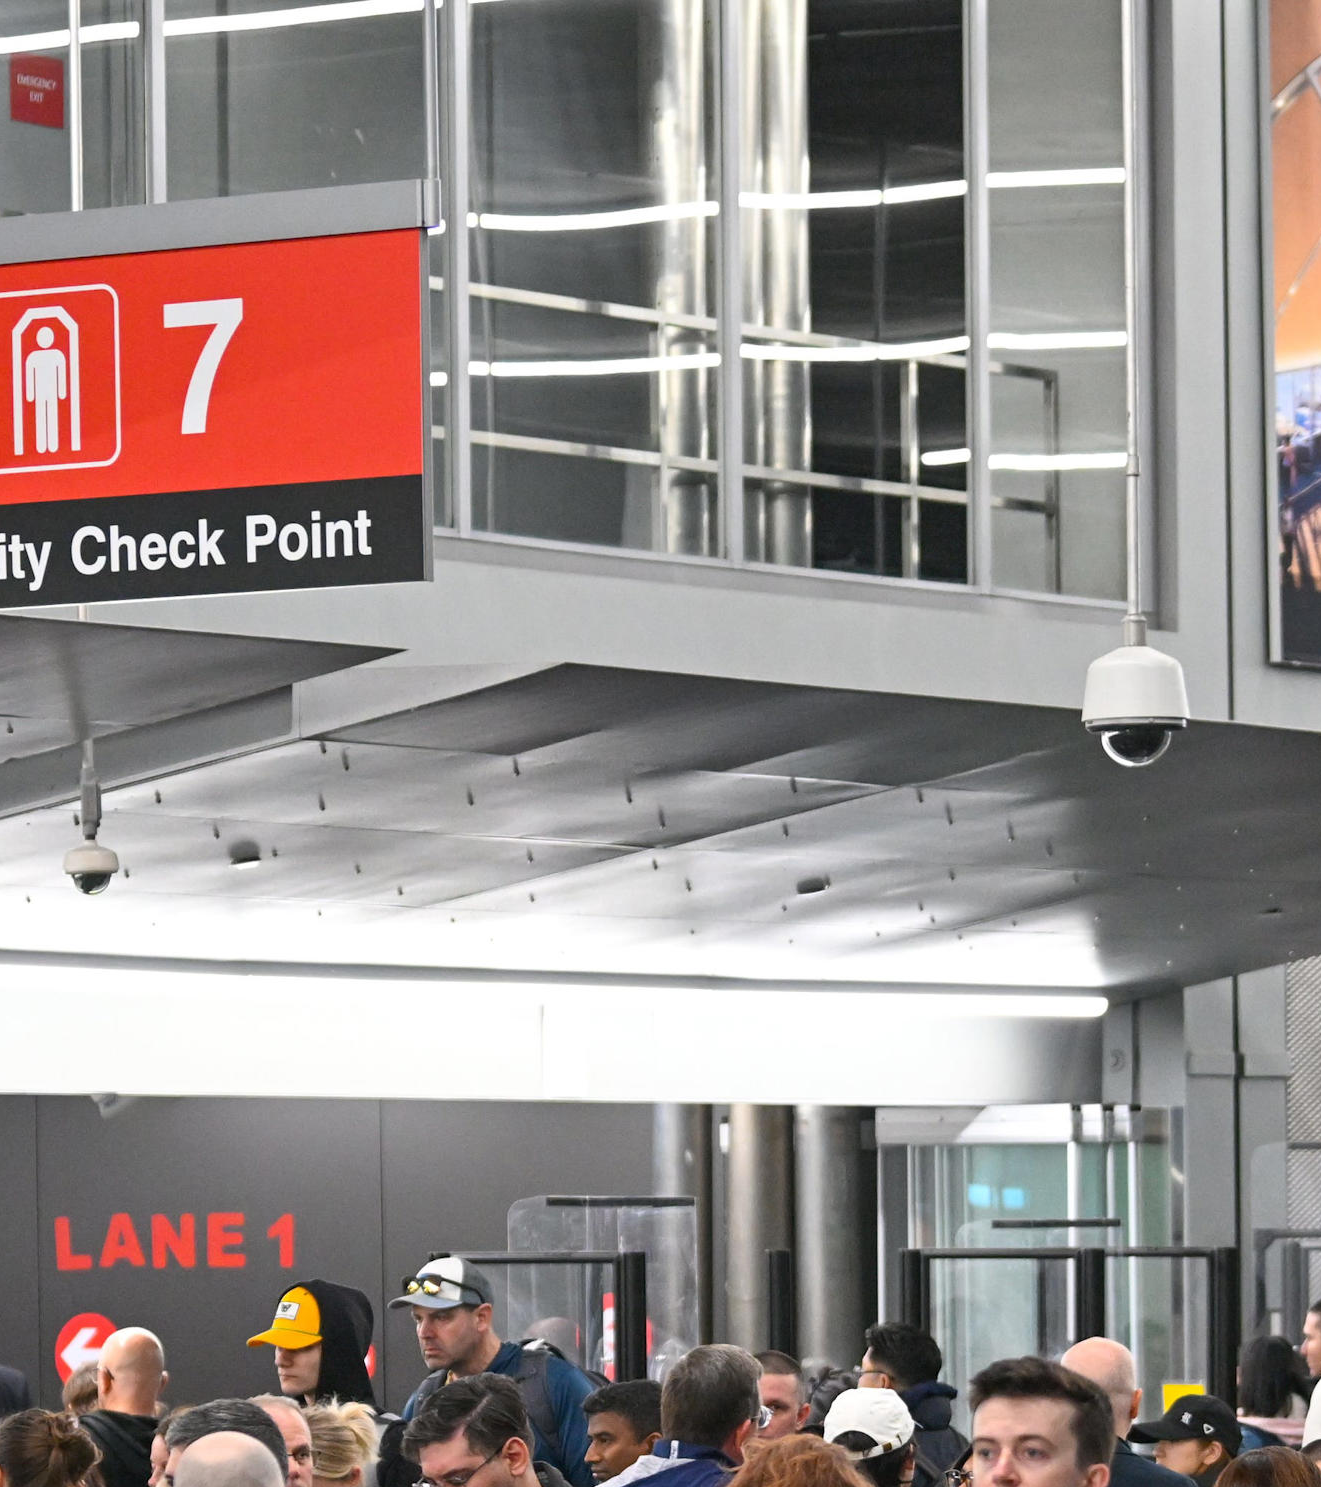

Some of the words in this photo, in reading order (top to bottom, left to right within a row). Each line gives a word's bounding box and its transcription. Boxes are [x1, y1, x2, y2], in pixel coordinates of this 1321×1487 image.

[16, 73, 57, 91] EMERGENCY
[29, 90, 44, 103] EXIT
[163, 297, 244, 436] 7
[70, 518, 226, 576] Check
[245, 509, 373, 564] Point
[54, 1212, 246, 1271] LANE
[266, 1213, 295, 1268] 1
